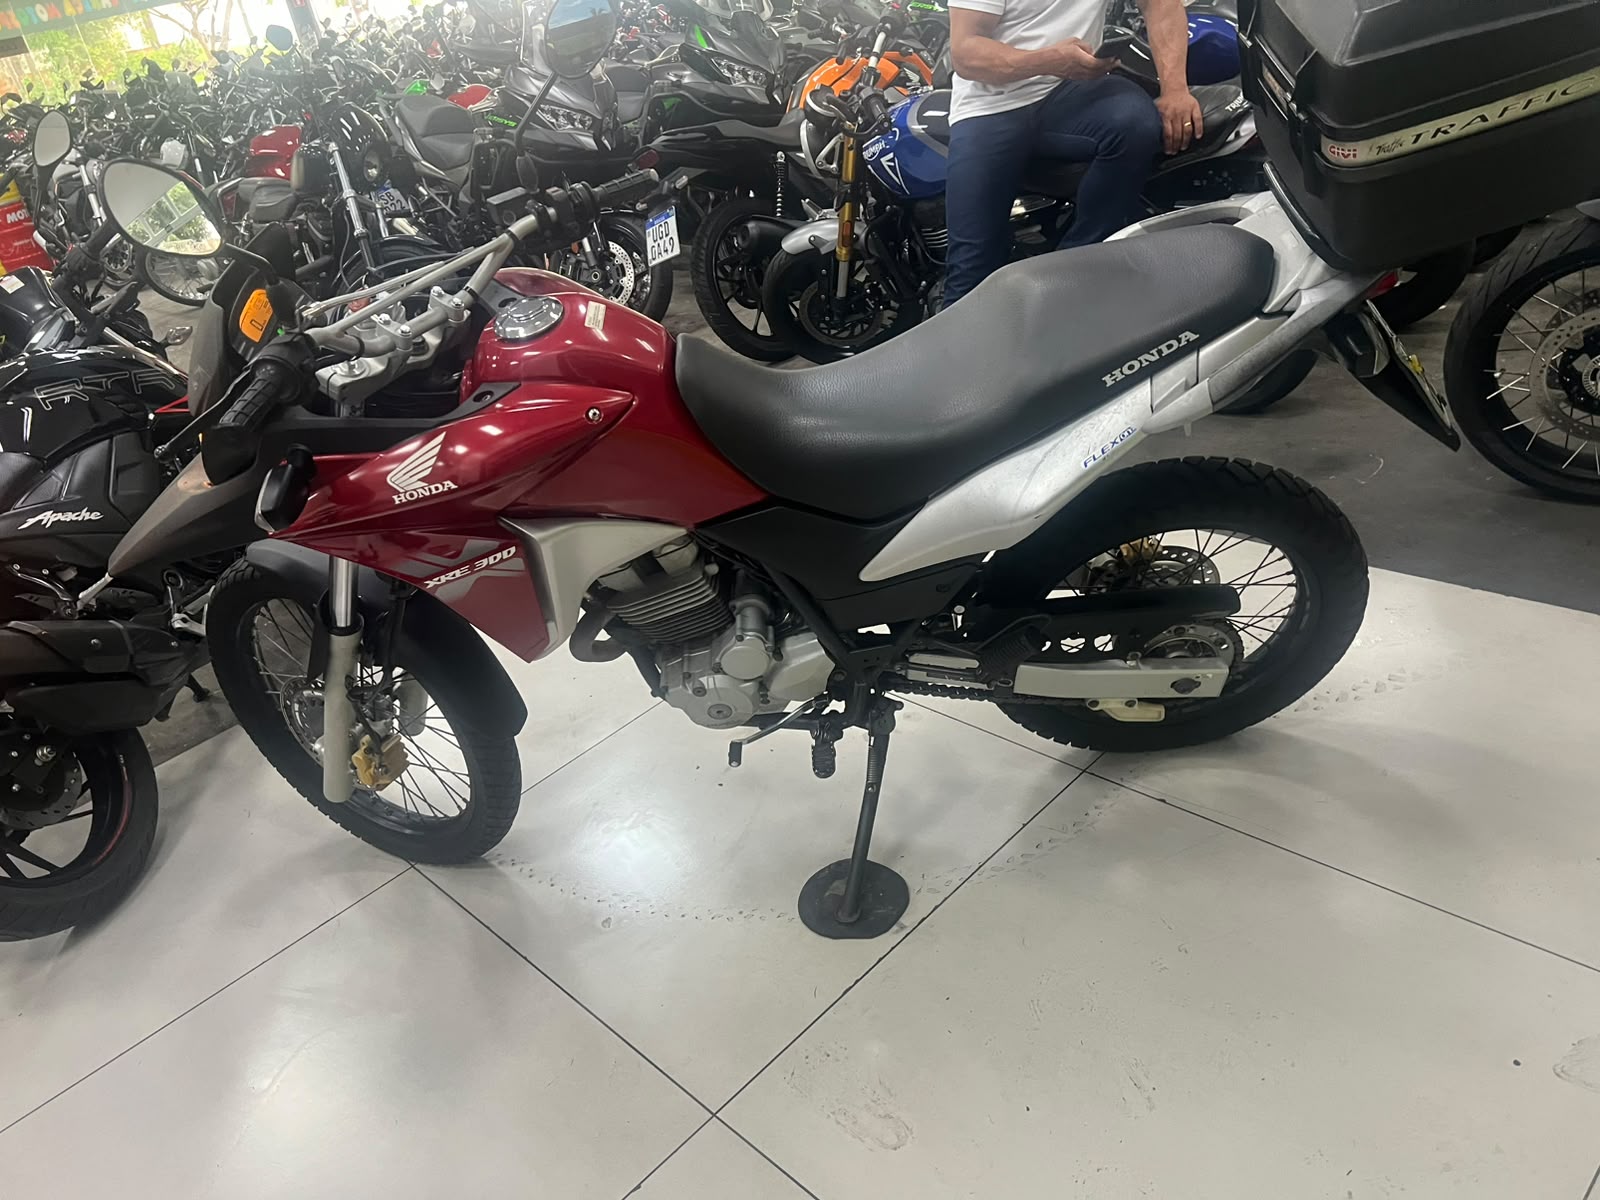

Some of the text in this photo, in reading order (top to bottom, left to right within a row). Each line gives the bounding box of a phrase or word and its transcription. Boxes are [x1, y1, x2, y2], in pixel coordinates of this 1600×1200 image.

[1411, 76, 1596, 145] TRAFFIC
[1329, 145, 1358, 159] GIVI
[651, 221, 670, 243] UGD
[1102, 330, 1199, 387] HONDA
[392, 480, 458, 505] HONDA
[17, 506, 105, 530] Apache
[423, 546, 517, 589] XRE 300
